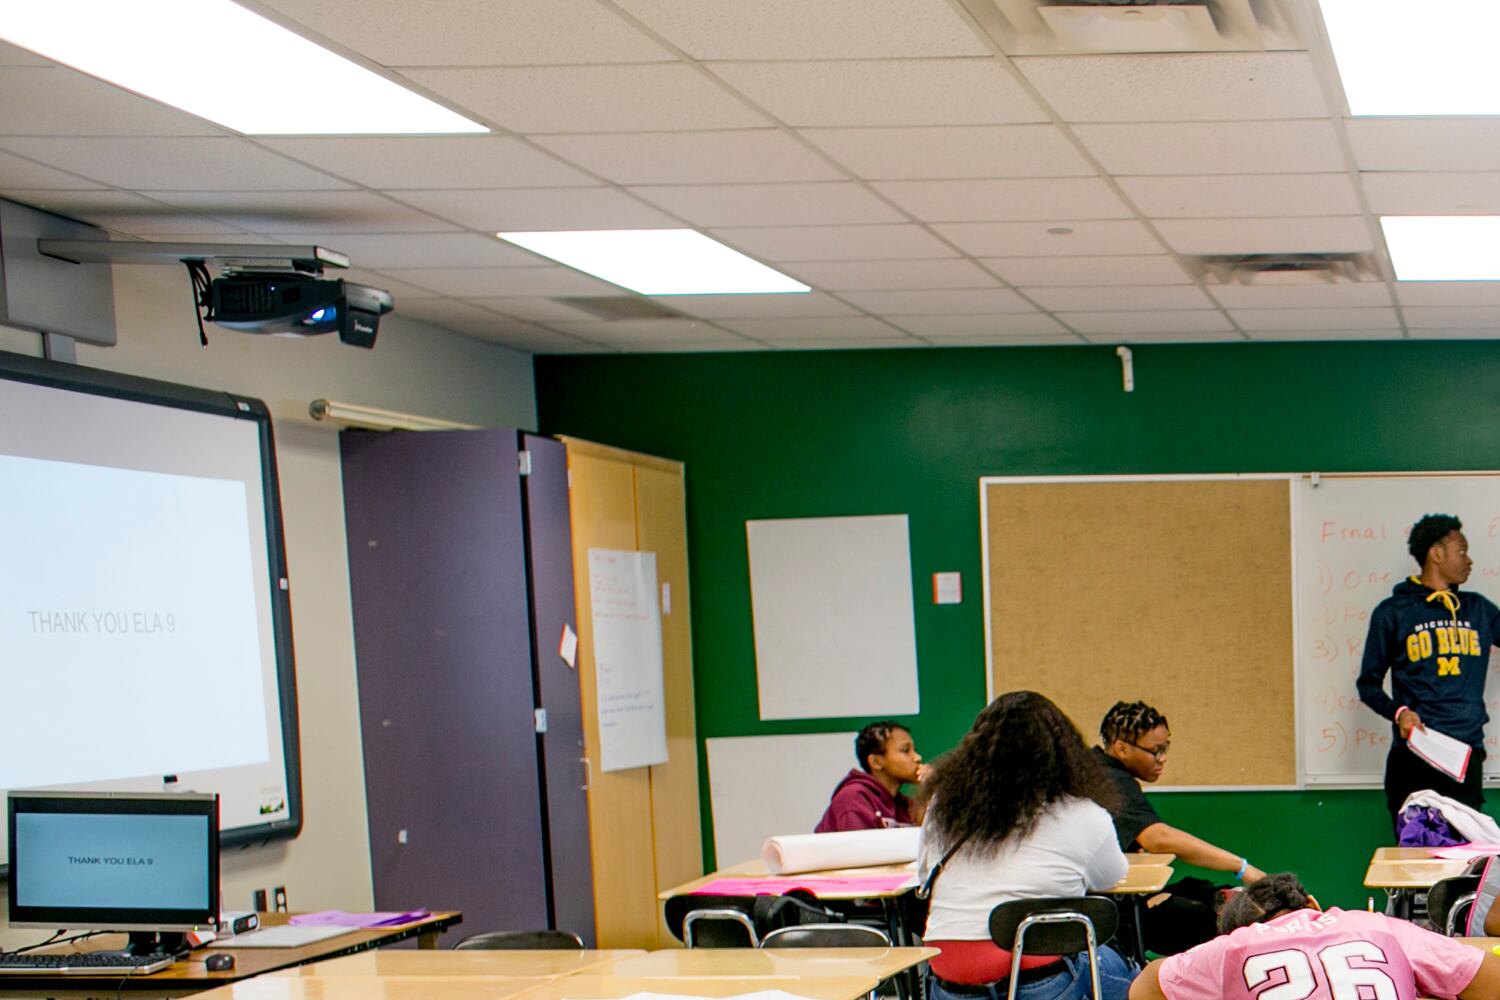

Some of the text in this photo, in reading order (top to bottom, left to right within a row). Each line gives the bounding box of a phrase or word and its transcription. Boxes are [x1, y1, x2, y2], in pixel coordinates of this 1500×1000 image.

[27, 611, 176, 634] THANK YOU ELA 9
[1406, 626, 1482, 663] GO BLUE
[1436, 655, 1462, 676] M
[68, 856, 101, 864] THANK
[103, 856, 125, 865] YOU
[127, 856, 145, 865] ELA
